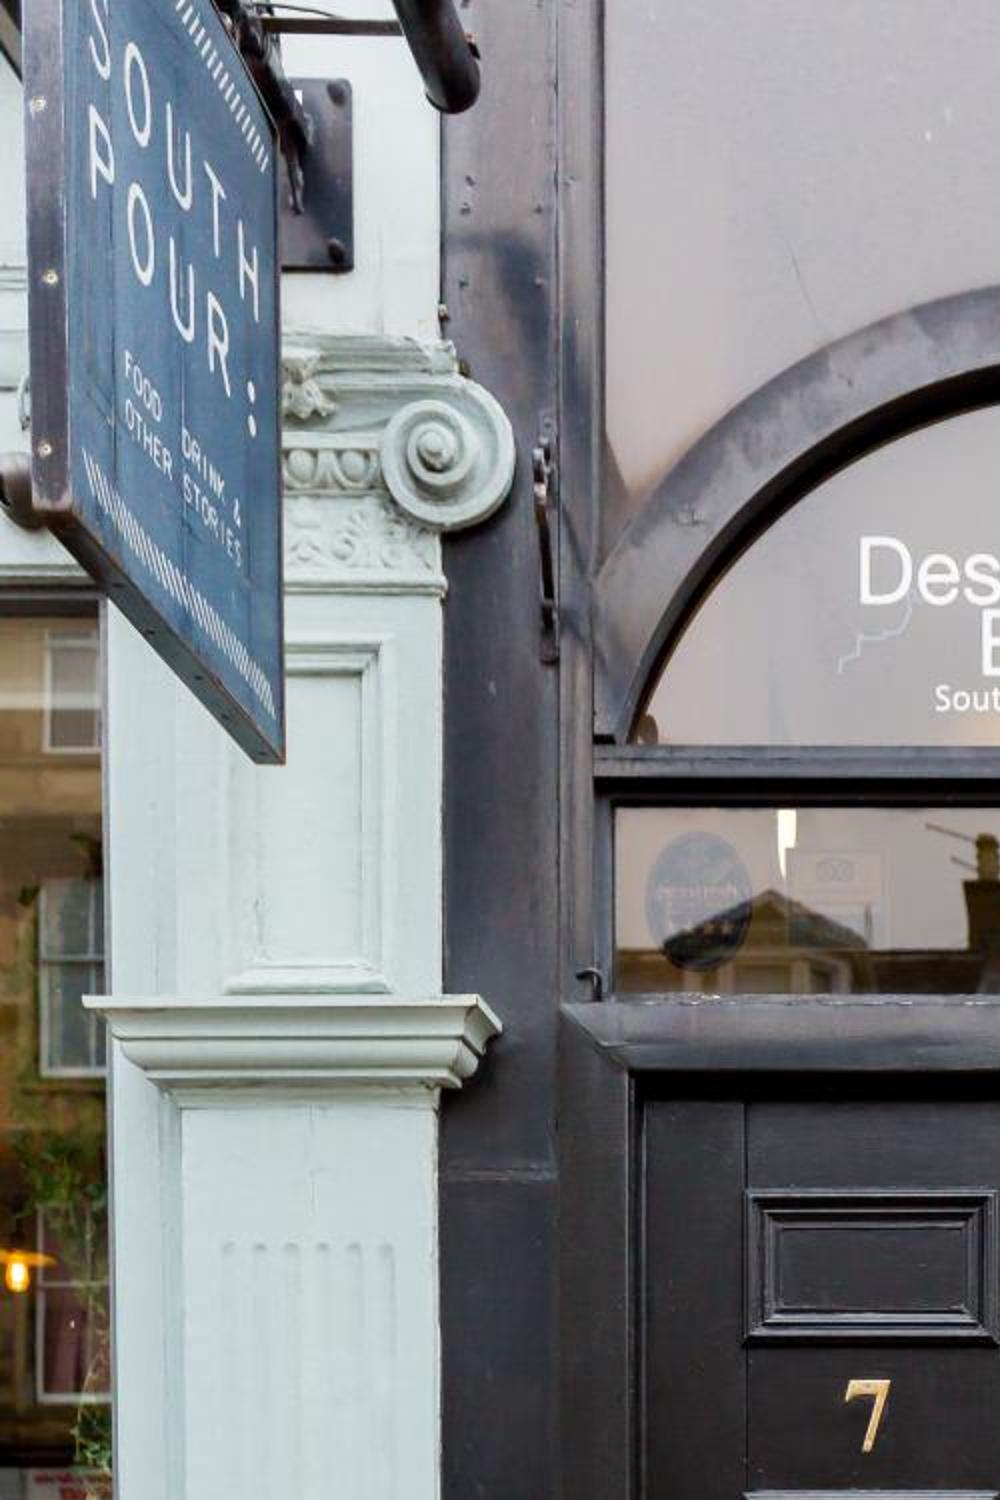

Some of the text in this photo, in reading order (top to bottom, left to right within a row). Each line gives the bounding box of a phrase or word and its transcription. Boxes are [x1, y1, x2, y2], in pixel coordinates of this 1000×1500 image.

[89, 0, 260, 323] SOUTH
[124, 349, 162, 424] FOOD
[181, 426, 226, 506] DRINK
[124, 399, 242, 568] OTHER STORIES
[845, 1379, 891, 1453] 7
